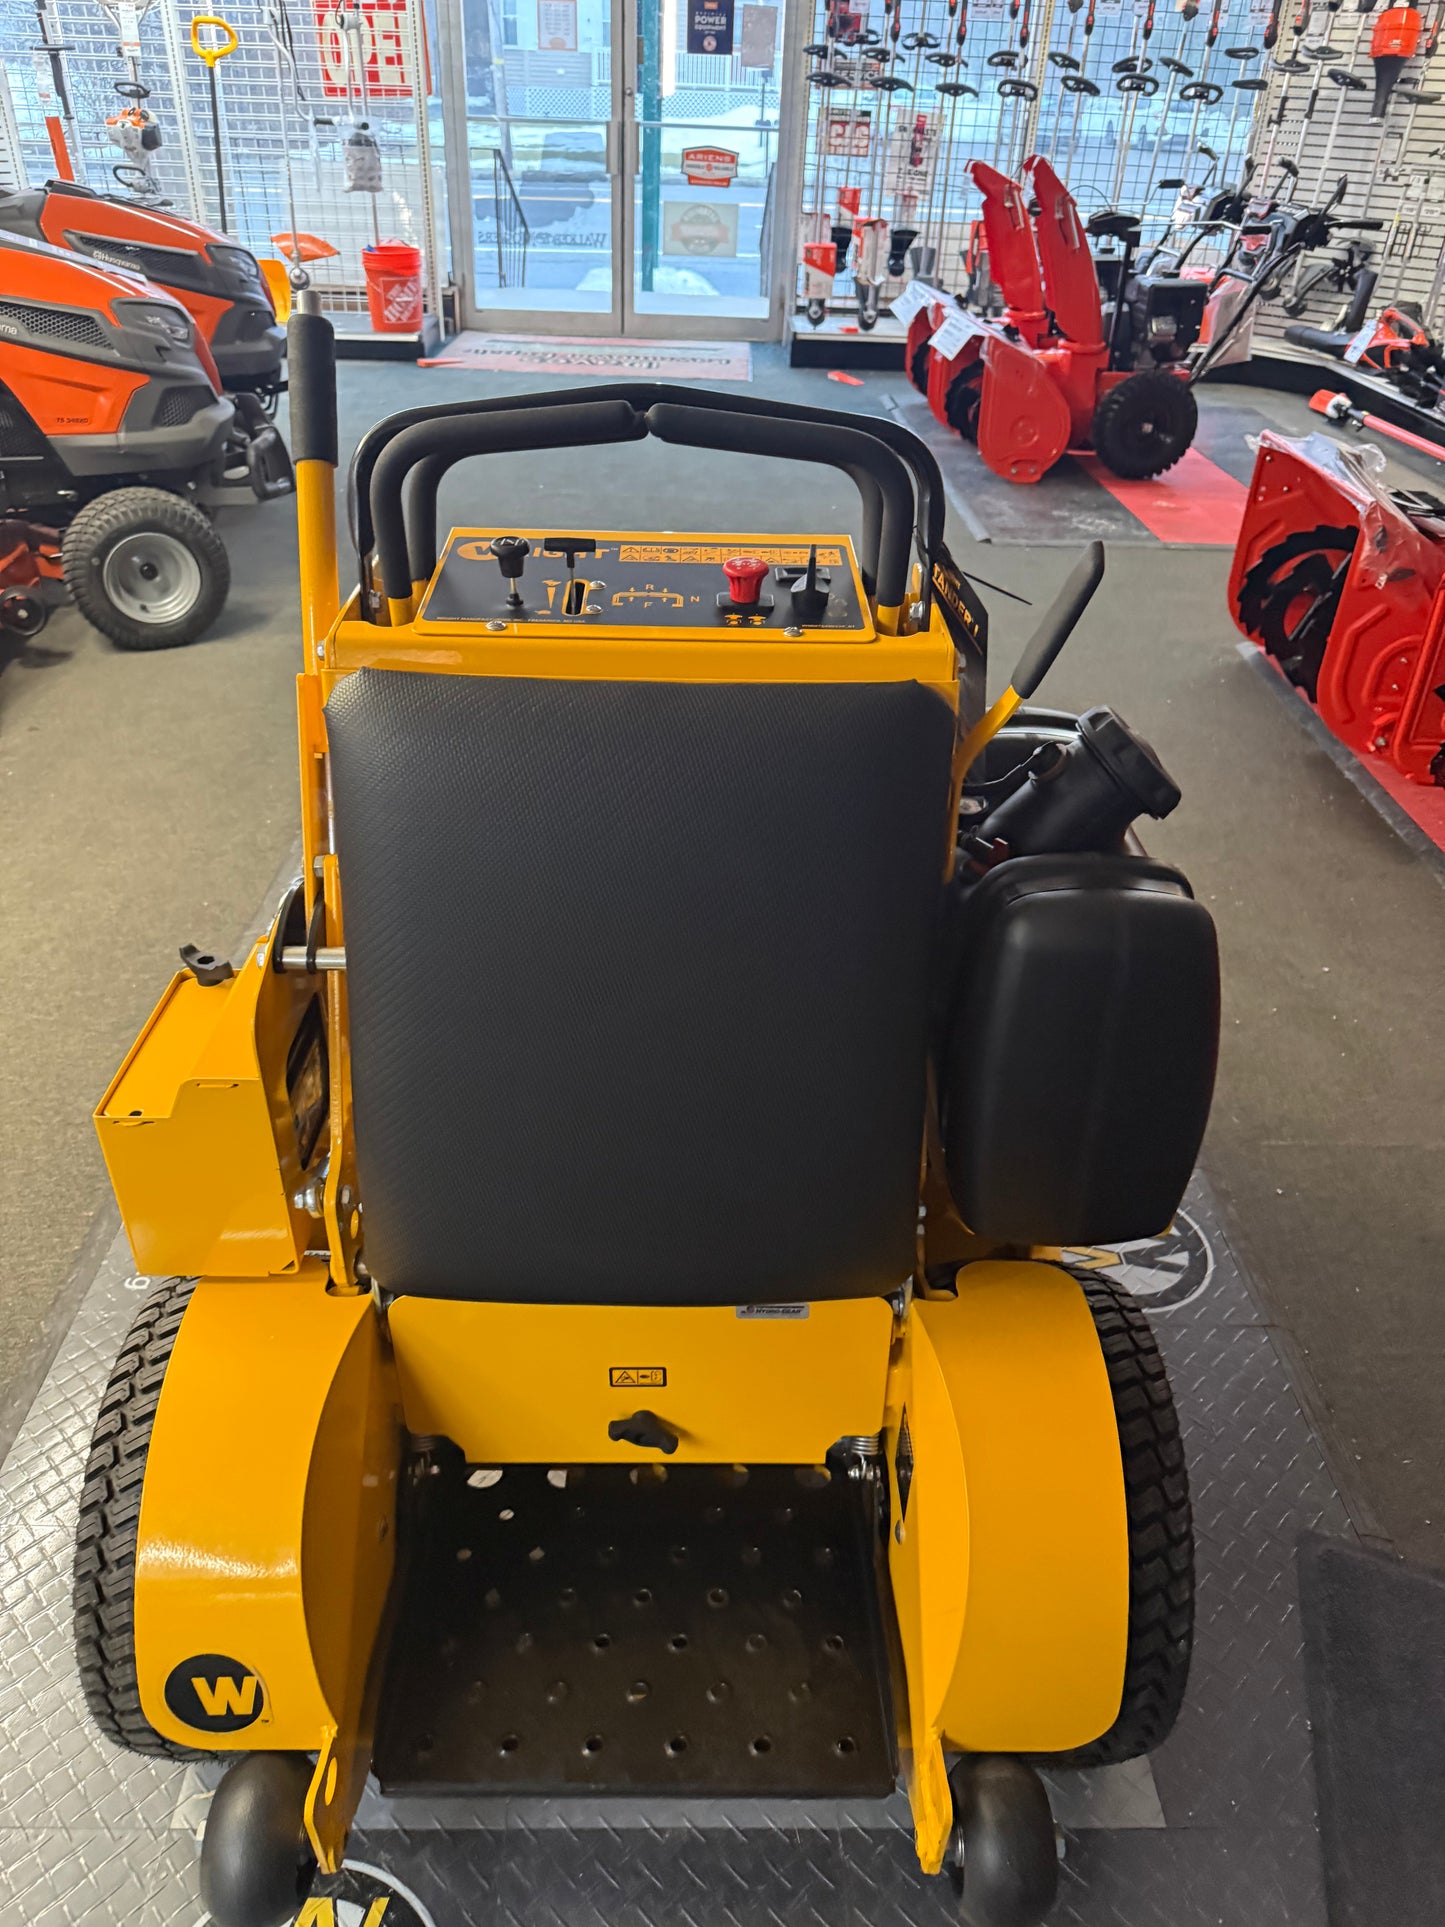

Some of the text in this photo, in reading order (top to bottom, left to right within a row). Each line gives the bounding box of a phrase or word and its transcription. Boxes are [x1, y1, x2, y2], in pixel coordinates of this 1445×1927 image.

[694, 15, 727, 25] POWER
[687, 152, 732, 163] ARIENS
[101, 252, 141, 271] Husqvarna
[933, 562, 973, 628] TANDER
[190, 1675, 258, 1716] W
